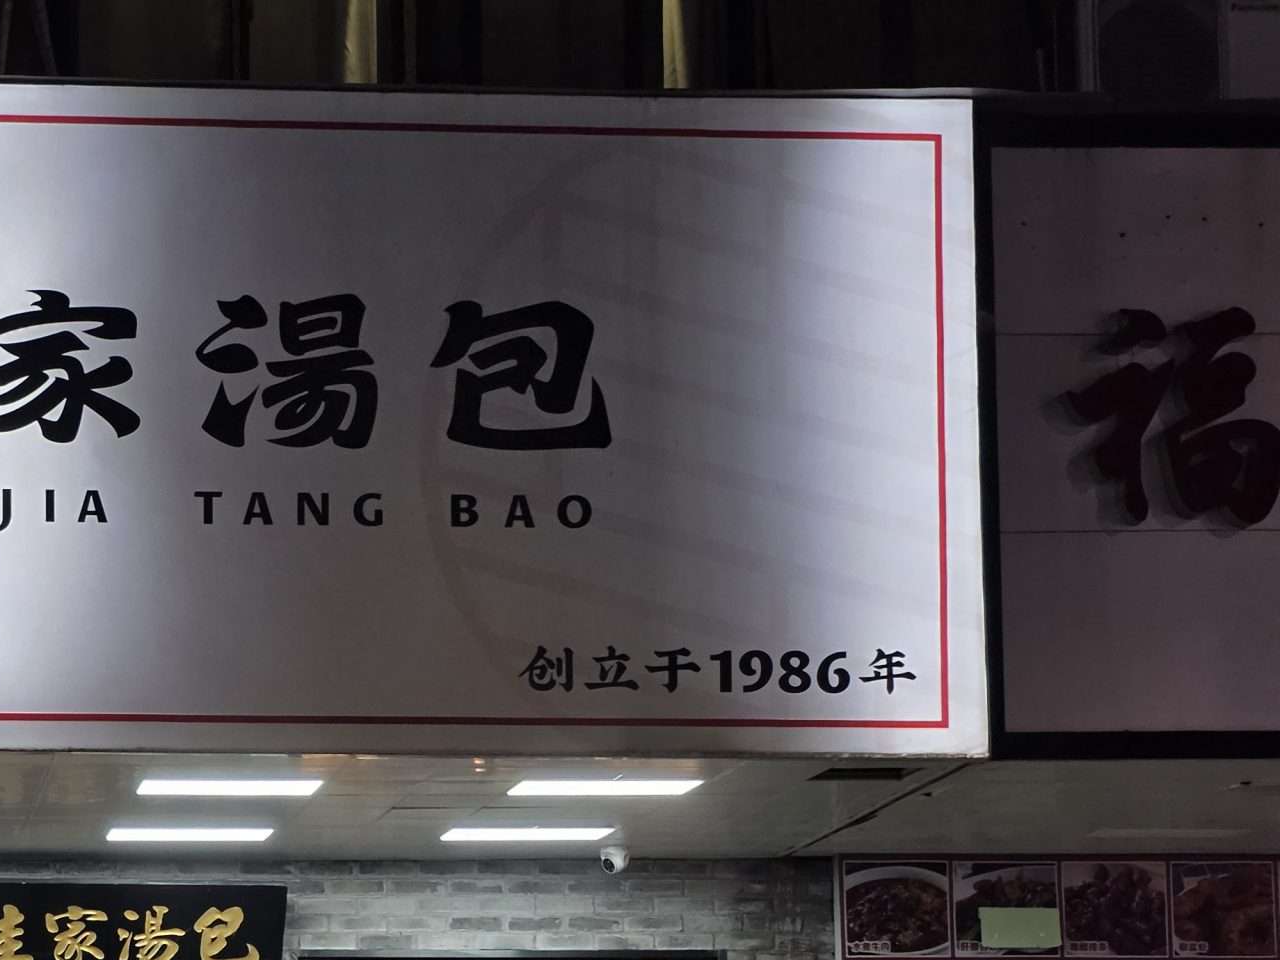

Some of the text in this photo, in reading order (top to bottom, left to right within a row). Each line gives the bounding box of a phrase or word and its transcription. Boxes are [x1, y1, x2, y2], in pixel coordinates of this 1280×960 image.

[194, 490, 387, 528] TANG
[451, 493, 594, 529] BAO
[518, 645, 918, 695] 创立于1986年
